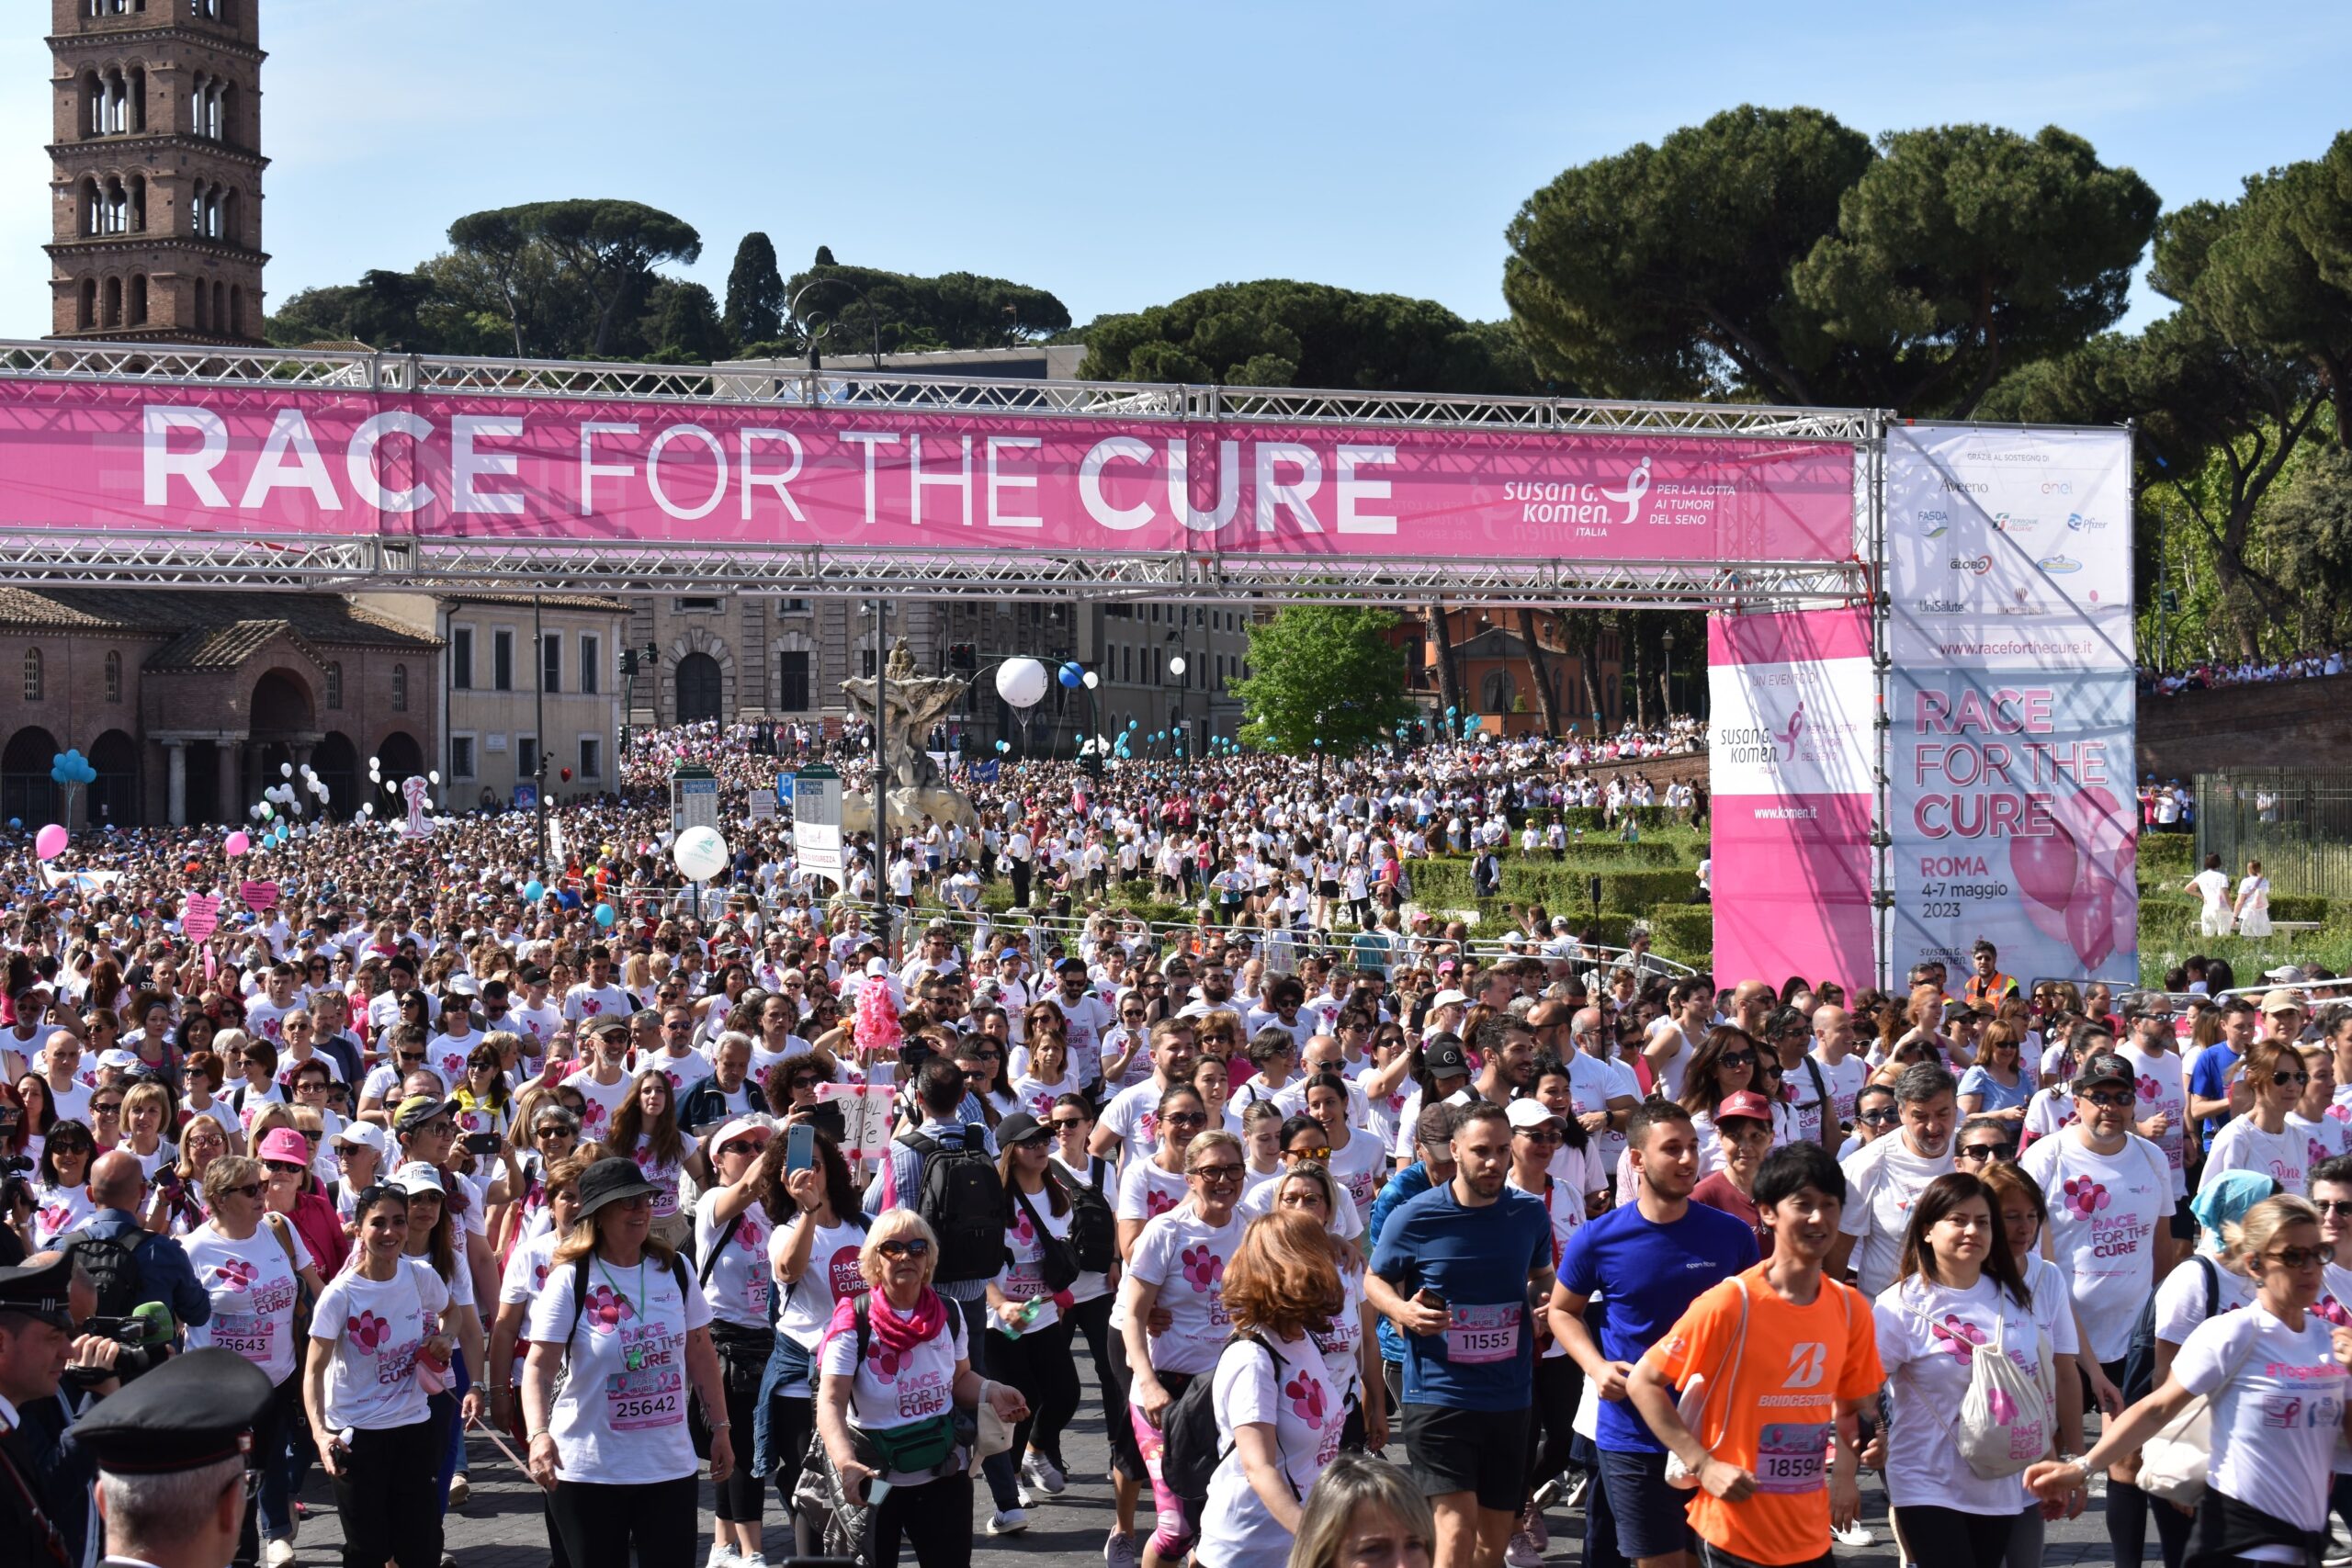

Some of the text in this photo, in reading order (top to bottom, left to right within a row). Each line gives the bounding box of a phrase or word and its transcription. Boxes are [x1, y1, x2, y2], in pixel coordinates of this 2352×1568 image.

[1967, 453, 1993, 461] GRAZIE
[2005, 454, 2041, 462] SOSTEGNO
[142, 404, 1397, 535] RACE FOR THE CURE
[1657, 484, 1736, 497] PER LA LOTTA
[1939, 479, 1989, 493] Aveeno
[2041, 482, 2074, 494] enel
[1655, 499, 1713, 512] AI TUMORI
[1649, 513, 1707, 526] DEL SENO
[1917, 511, 1949, 521] FASDA
[1576, 526, 1608, 537] ITALIA
[2083, 517, 2109, 534] Pfizer
[1950, 559, 1986, 570] GLOBO
[1918, 600, 1964, 614] UniSalute
[1939, 640, 2093, 655] www.raceforthecure.it
[1753, 672, 1818, 687] UN EVENTO DI
[1914, 689, 2054, 735] RACE
[1806, 726, 1821, 734] PER
[1834, 724, 1858, 733] LOTTA
[1801, 752, 1815, 761] DEL
[1914, 741, 2109, 786] FOR THE
[1754, 806, 1817, 819] www.komen.it
[1912, 792, 2056, 840] CURE
[1920, 856, 1989, 877] ROMA
[1921, 881, 2007, 899] 4-7 maggio
[1922, 903, 1961, 918] 2023
[1800, 1115, 1819, 1128] CURE
[648, 1168, 679, 1179] FOR THE
[2091, 1213, 2138, 1232] RACE
[2092, 1224, 2152, 1246] FOR THE
[2093, 1240, 2138, 1259] CURE
[836, 1271, 859, 1282] FOR
[251, 1274, 291, 1298] RACE
[839, 1280, 870, 1292] CURE
[254, 1285, 299, 1307] FOR TH
[256, 1296, 292, 1315] CURE
[619, 1321, 669, 1345] RACE
[1337, 1324, 1360, 1340] THE
[1462, 1331, 1510, 1349] 11555
[215, 1337, 266, 1352] 25643
[377, 1338, 417, 1363] RACE
[623, 1332, 684, 1359] FOR THE
[379, 1358, 408, 1375] FOR
[625, 1350, 672, 1372] CURE
[378, 1363, 415, 1385] CURE
[897, 1371, 940, 1394] RACE
[616, 1395, 676, 1417] 25642
[899, 1389, 933, 1407] FOR
[899, 1398, 944, 1419] CURE
